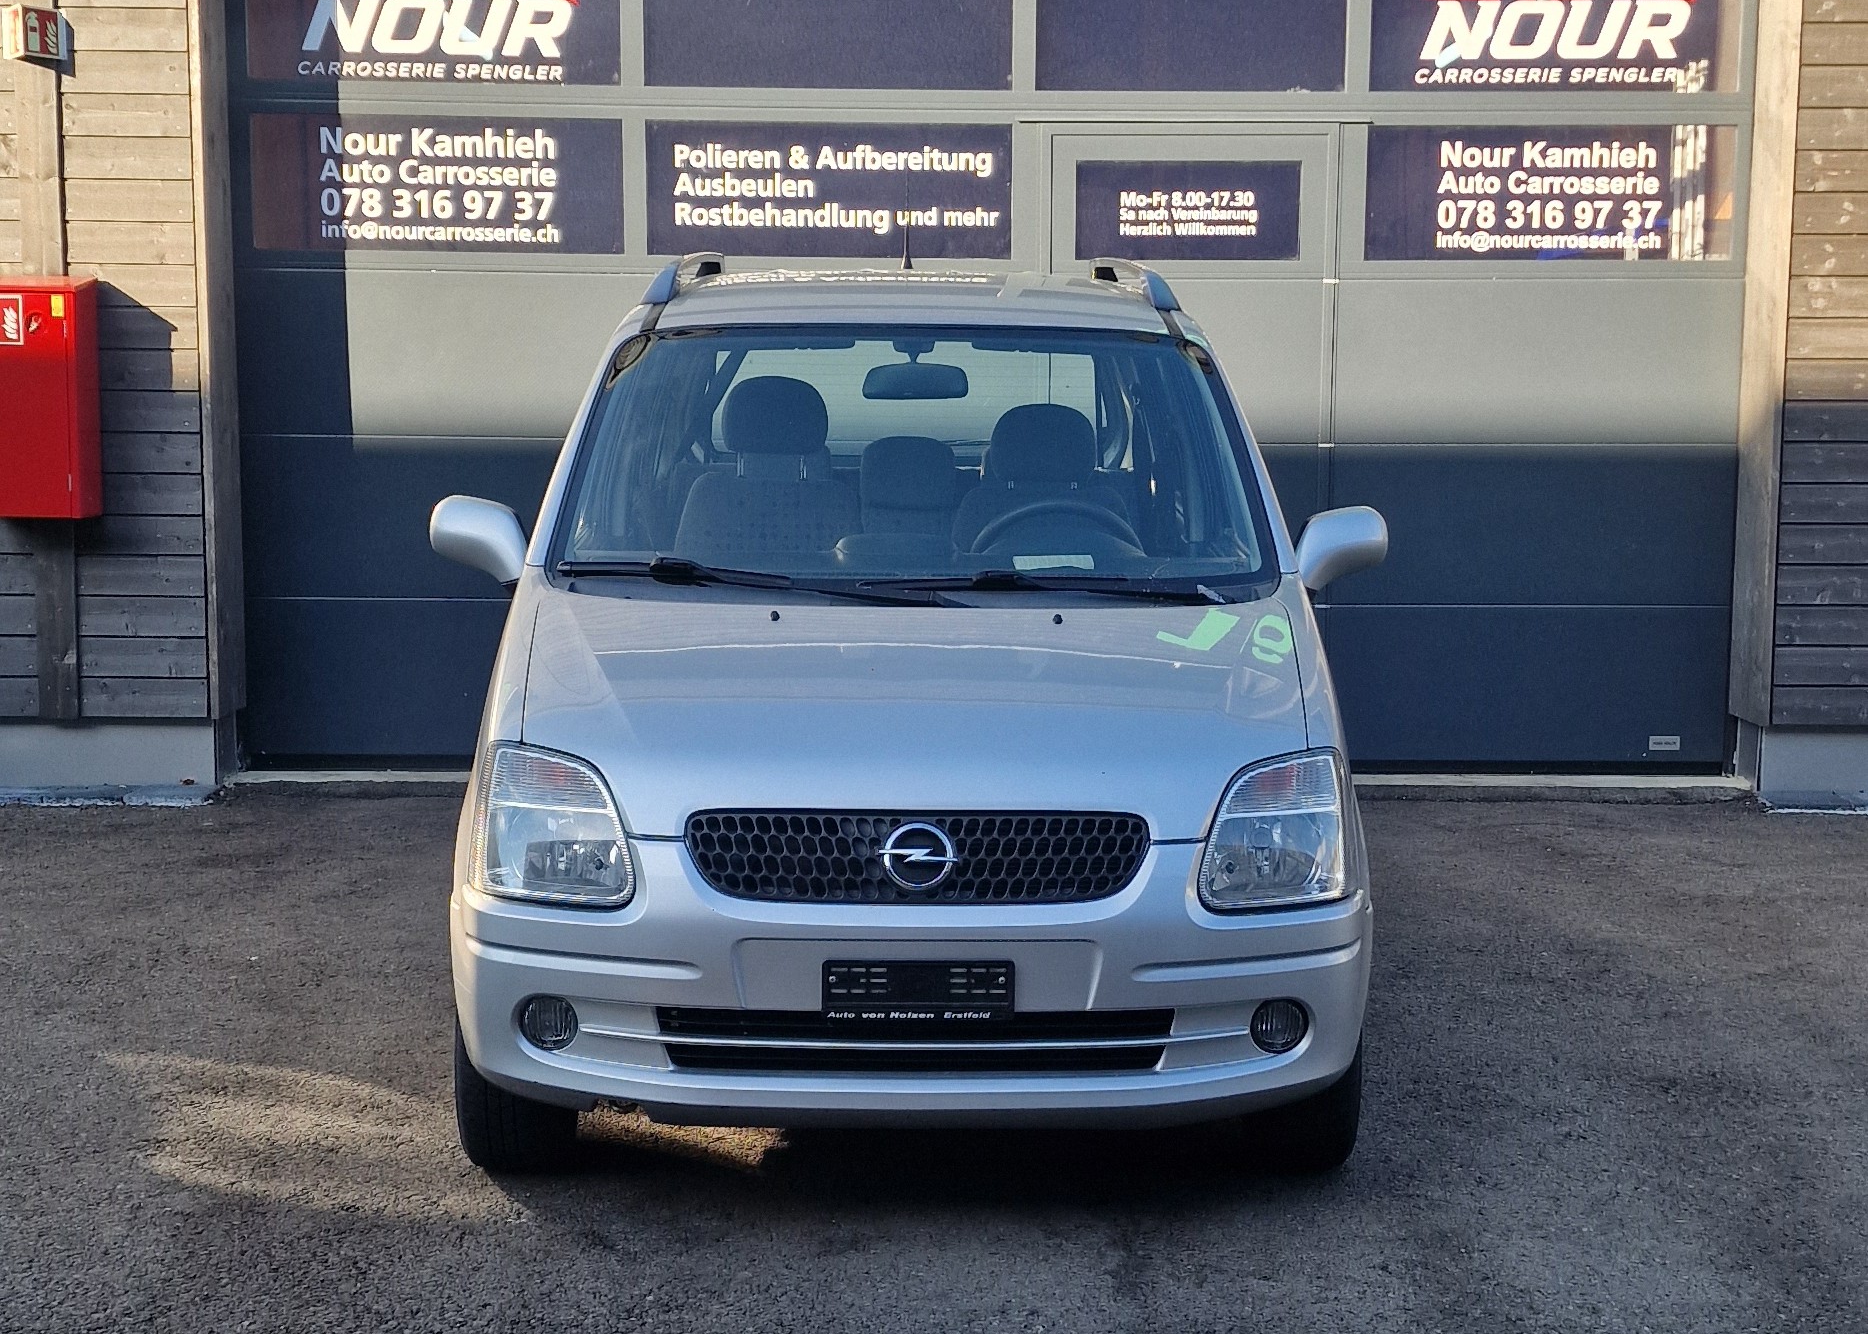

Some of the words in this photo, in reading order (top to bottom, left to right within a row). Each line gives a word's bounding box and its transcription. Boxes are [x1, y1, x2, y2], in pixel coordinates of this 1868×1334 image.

[1419, 0, 1692, 60] NOUR
[298, 60, 446, 79] CARROSSERIE
[454, 63, 563, 81] SPENGLER
[1414, 67, 1562, 84] CARROSSERIE
[1569, 66, 1678, 84] SPENGLER
[319, 126, 402, 156] Nour
[411, 127, 556, 160] Kamhieh
[1439, 140, 1516, 168] Nour
[1522, 140, 1658, 168] Kamhieh
[319, 158, 391, 183] Auto
[399, 160, 558, 187] Carrosserie
[673, 142, 781, 170] Polieren
[788, 145, 810, 170] &
[815, 144, 993, 178] Aufbereitung
[673, 172, 815, 198] Ausbeulen
[1436, 170, 1501, 195] Auto
[1507, 170, 1660, 195] Carrosserie
[320, 187, 382, 218] 078
[392, 189, 453, 220] 316
[462, 191, 504, 220] 97
[513, 191, 555, 221] 37
[1119, 191, 1168, 207] Mo-Fr
[1171, 191, 1255, 207] 8.00-17.30
[674, 201, 890, 235] Rostbehandlung
[895, 206, 938, 227] und
[943, 206, 1001, 227] mehr
[1119, 208, 1137, 221] Sa
[1138, 208, 1169, 221] nach
[1171, 208, 1258, 223] Vereinbarung
[1436, 199, 1496, 229] 078
[1504, 199, 1565, 229] 316
[1574, 199, 1614, 229] 97
[1621, 199, 1663, 229] 37
[320, 219, 560, 243] info@nourcarrosserie.ch
[1119, 223, 1172, 236] Herzlich
[1173, 222, 1257, 237] Willkommen
[1435, 230, 1661, 253] info@nourcarrosserie.ch
[826, 1011, 856, 1019] Auto
